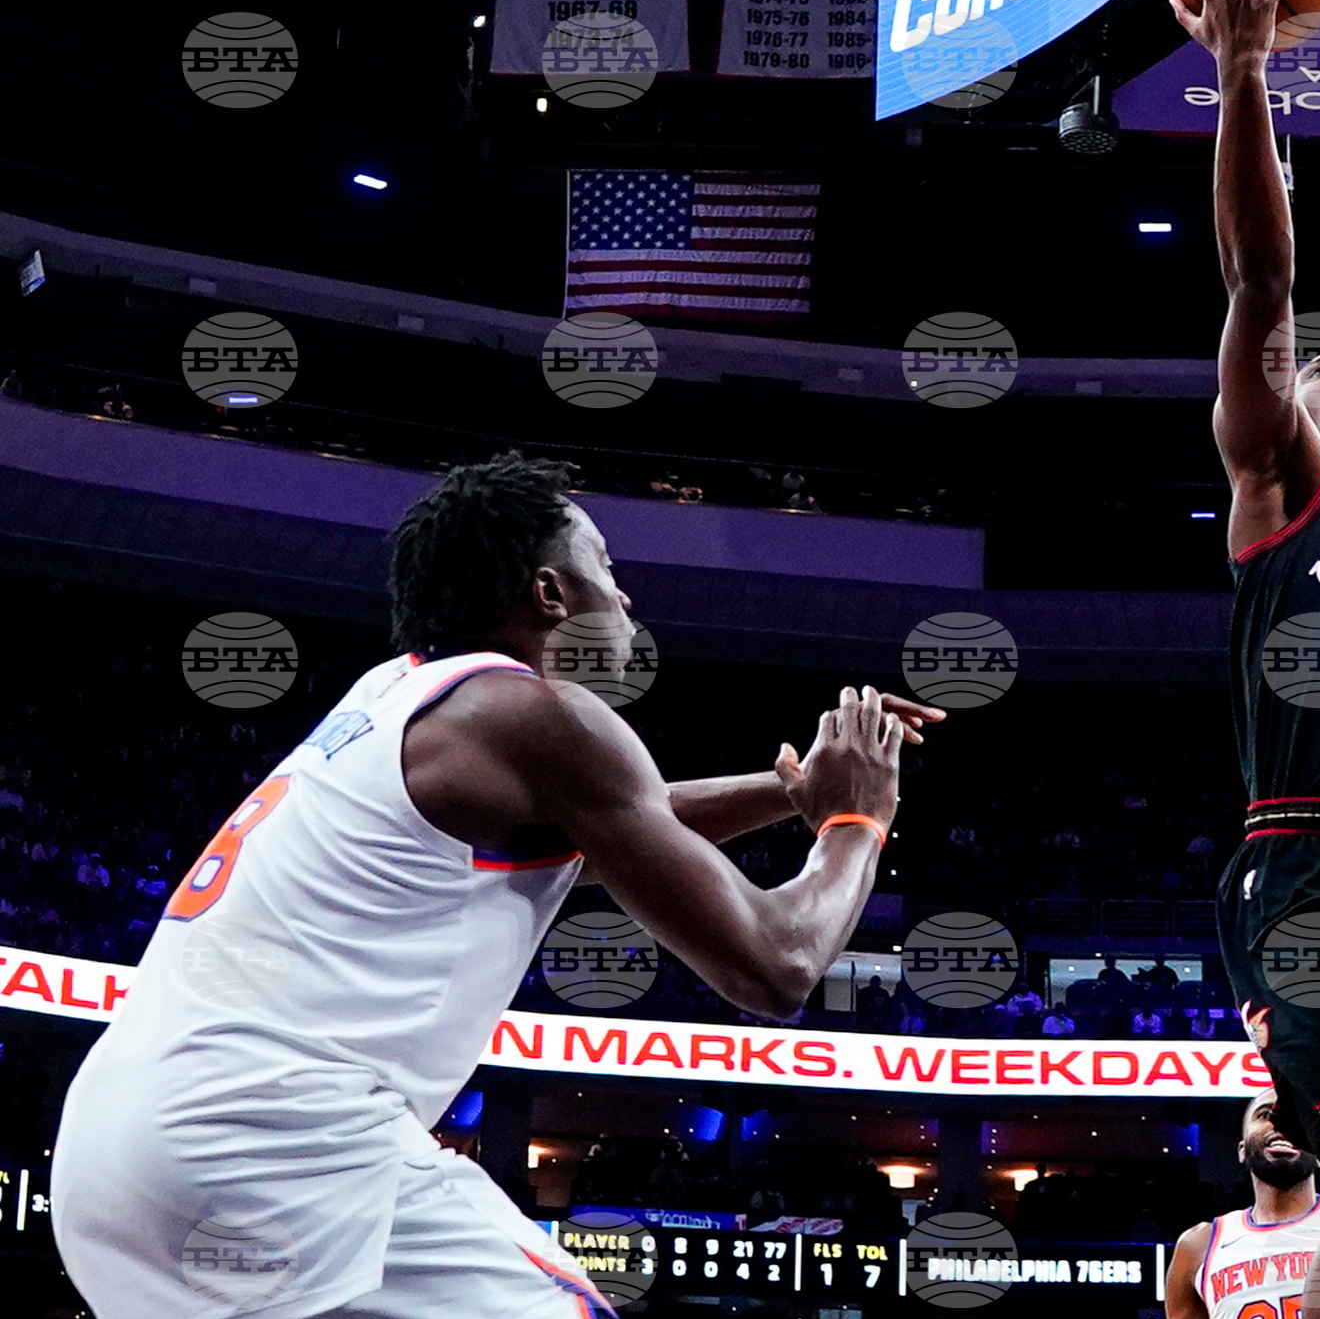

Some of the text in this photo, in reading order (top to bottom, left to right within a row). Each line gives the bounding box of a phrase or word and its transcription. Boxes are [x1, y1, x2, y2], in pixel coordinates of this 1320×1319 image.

[547, 0, 639, 22] 1967-68
[164, 775, 294, 921] 8
[0, 957, 130, 1012] ALK
[563, 1027, 854, 1079] MARKS.
[873, 1045, 1276, 1089] WEEKDAYS
[564, 1233, 630, 1251] PLAYER
[641, 1236, 656, 1252] 0
[733, 1241, 754, 1258] 21
[764, 1242, 787, 1259] 77
[813, 1243, 843, 1258] FLS
[856, 1244, 888, 1261] TOL
[576, 1256, 881, 1288] OINTS 3 0 0 4 2 1 7
[927, 1258, 1142, 1284] PHILADELPHIA 76ERS
[1211, 1257, 1269, 1304] NEW
